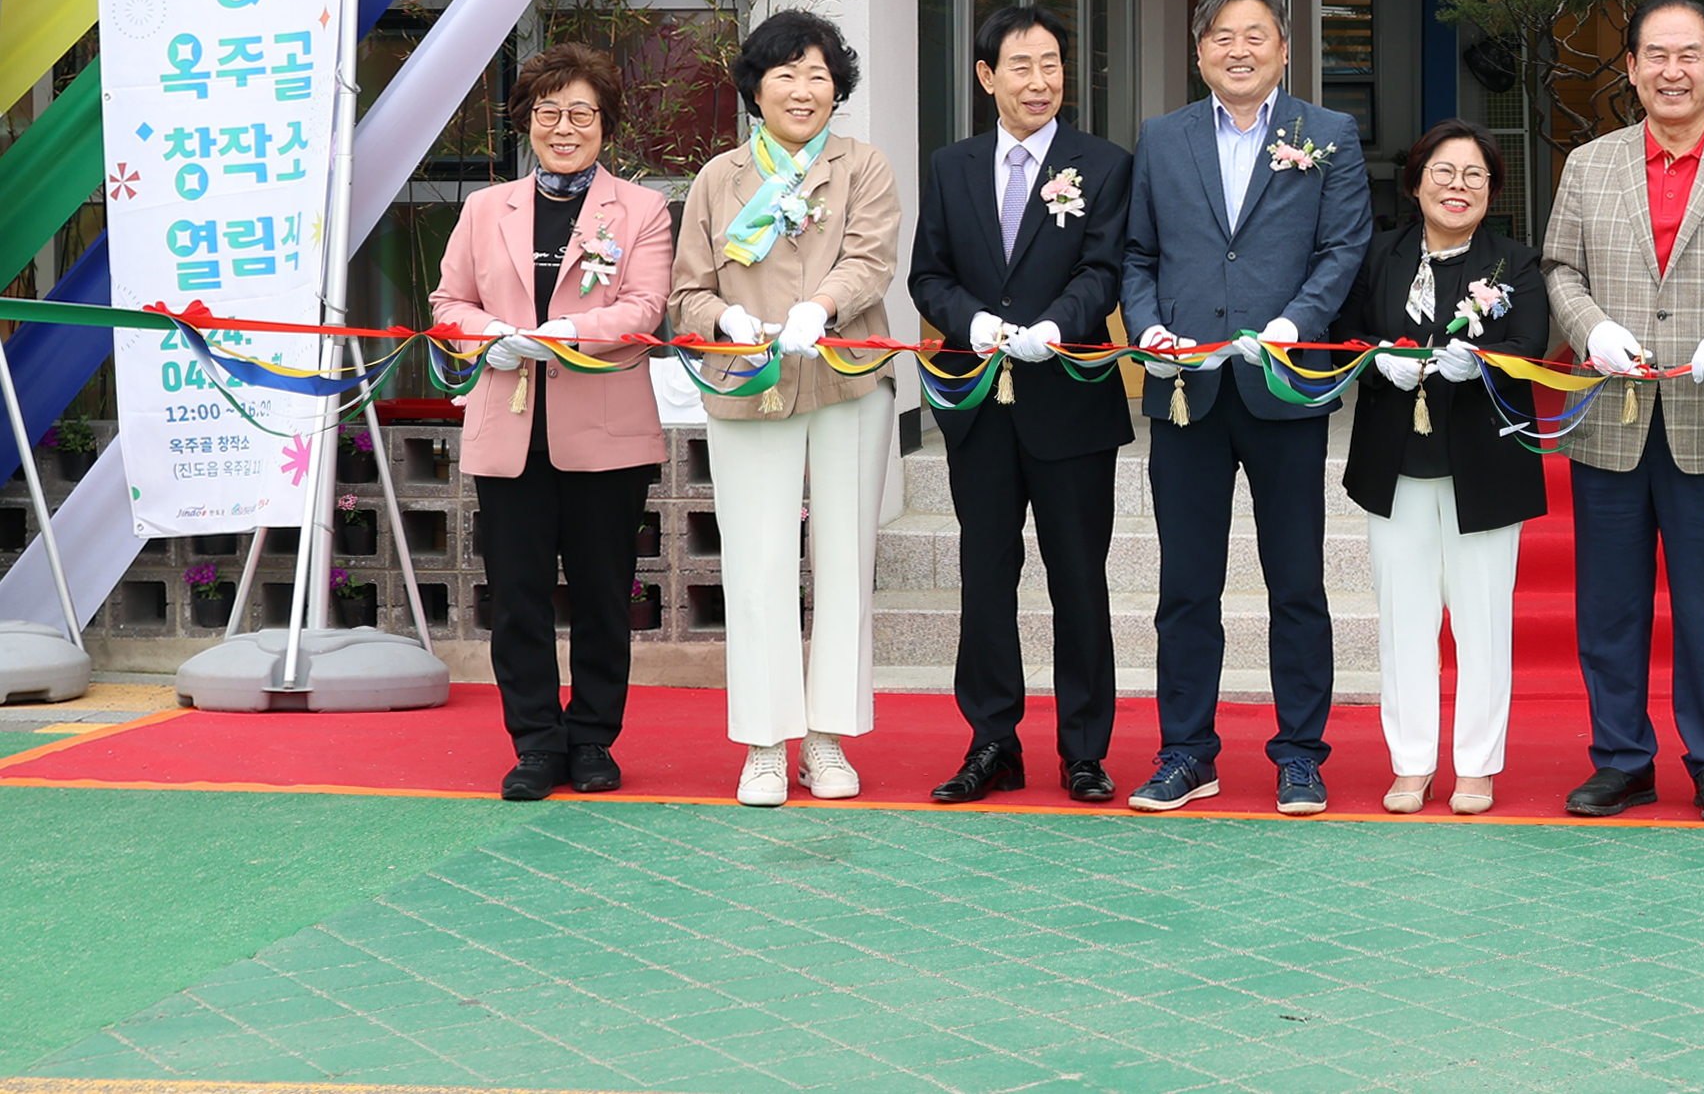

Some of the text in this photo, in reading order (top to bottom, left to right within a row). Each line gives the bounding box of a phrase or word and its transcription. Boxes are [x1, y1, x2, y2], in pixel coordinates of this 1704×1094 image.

[160, 31, 313, 102] 옥주골
[163, 122, 308, 200] 창작소
[166, 403, 220, 422] 12:00
[170, 436, 249, 454] 옥주골 창작소
[173, 461, 218, 480] (진도읍
